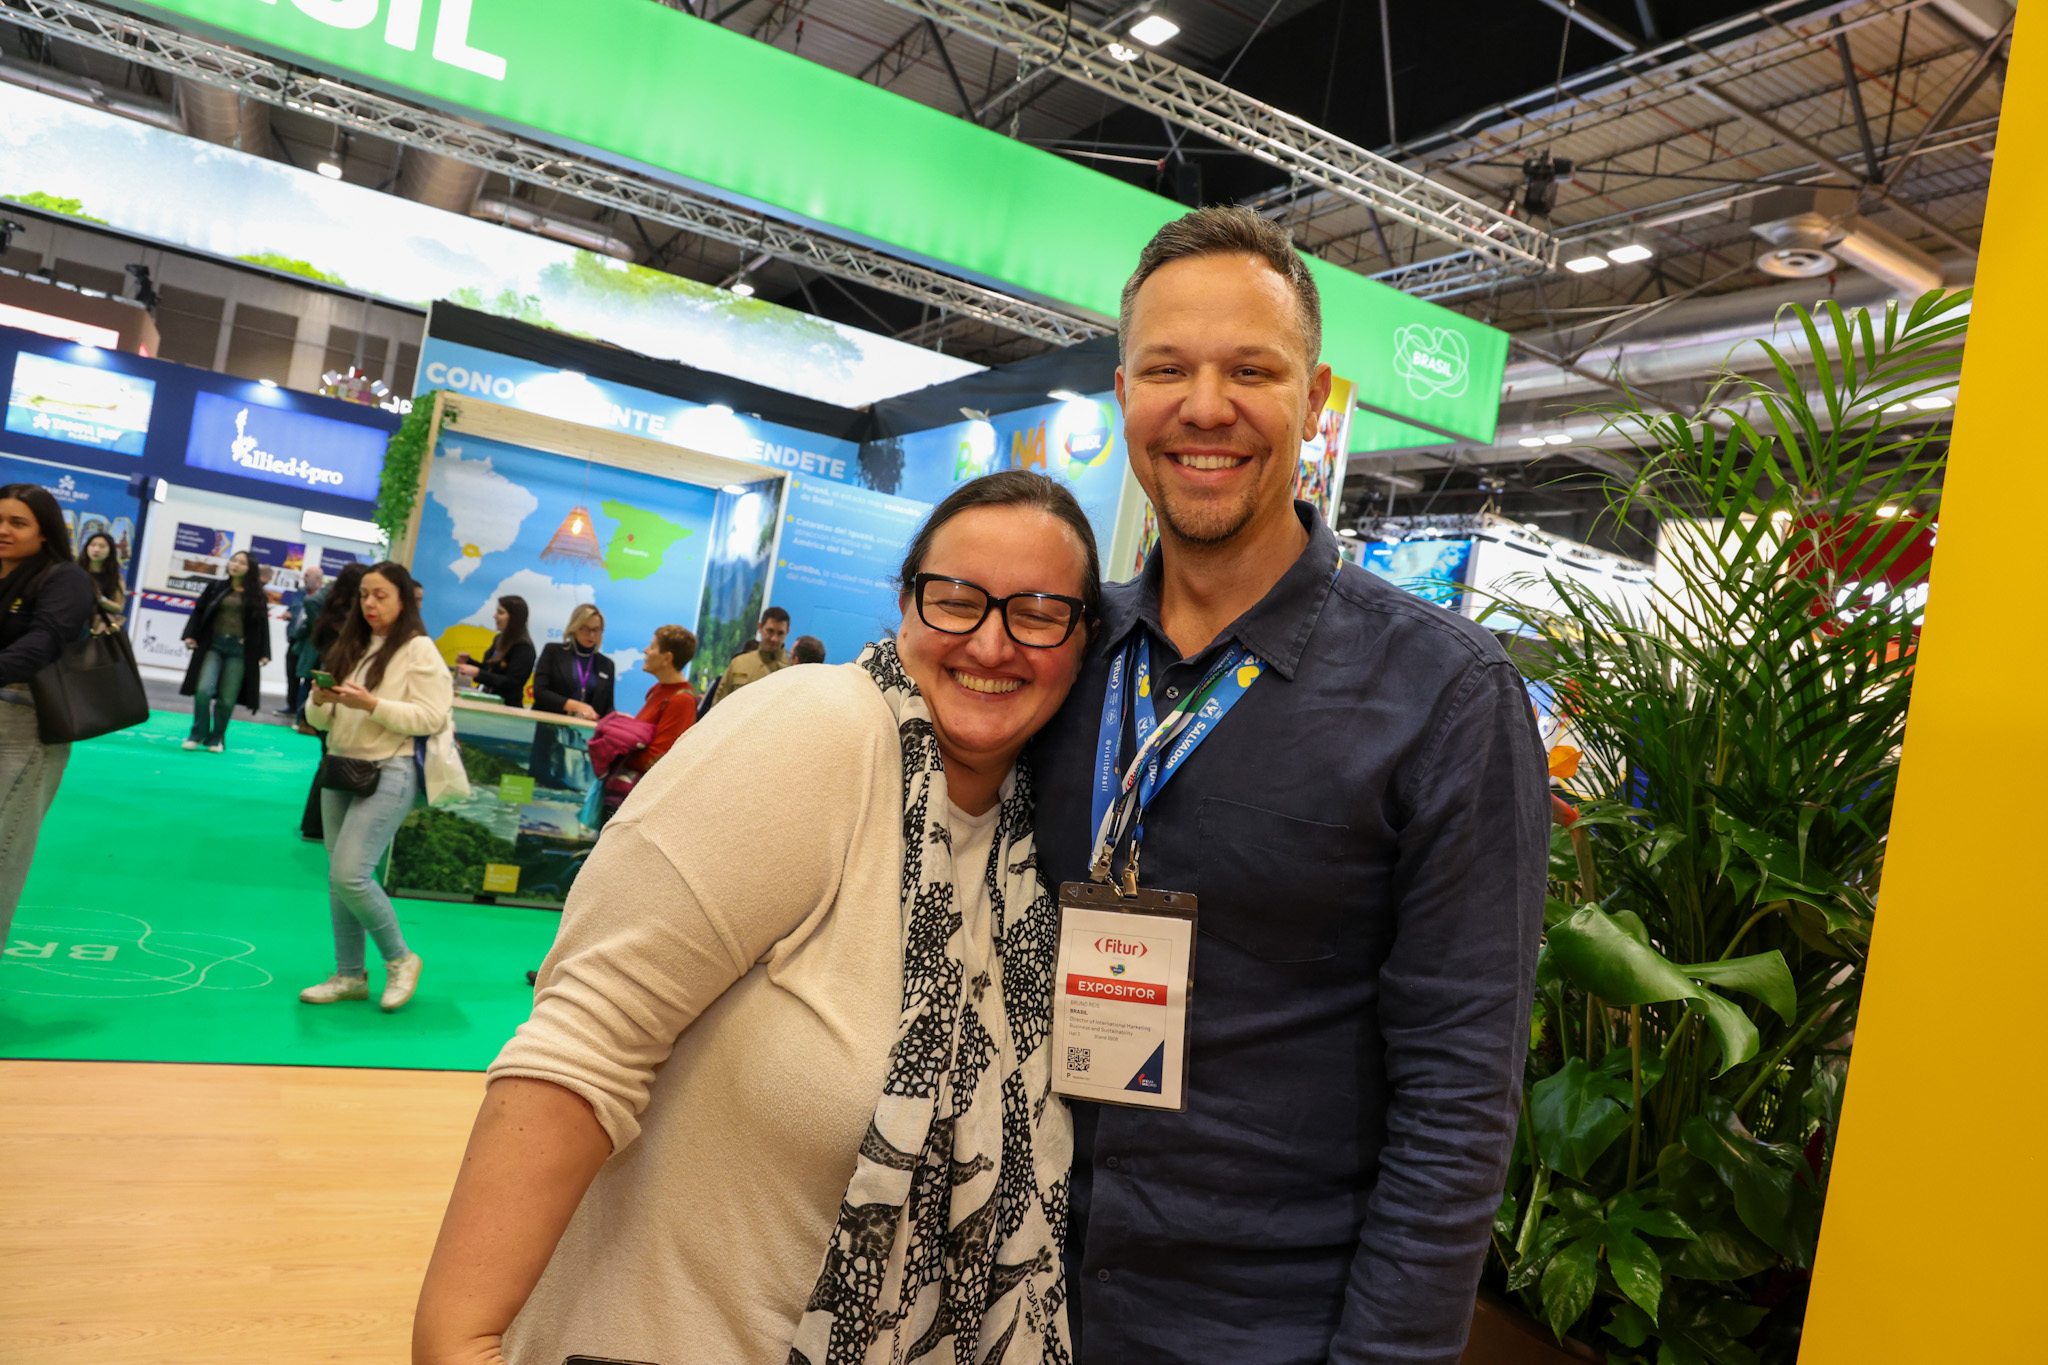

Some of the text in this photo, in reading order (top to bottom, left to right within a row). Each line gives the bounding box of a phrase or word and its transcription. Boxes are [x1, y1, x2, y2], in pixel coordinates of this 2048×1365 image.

[1412, 350, 1453, 378] BRASIL
[1165, 721, 1207, 770] SALVADOR
[1101, 739, 1113, 792] @visitbrasil
[1105, 938, 1139, 956] Fitur
[1077, 980, 1156, 1000] EXPOSITOR
[1069, 1008, 1088, 1016] BRASIL
[1069, 1016, 1089, 1024] Director
[1095, 1019, 1126, 1029] International
[1126, 1023, 1151, 1033] Marketing
[1069, 1023, 1090, 1031] Business
[1101, 1026, 1134, 1037] Sustainability
